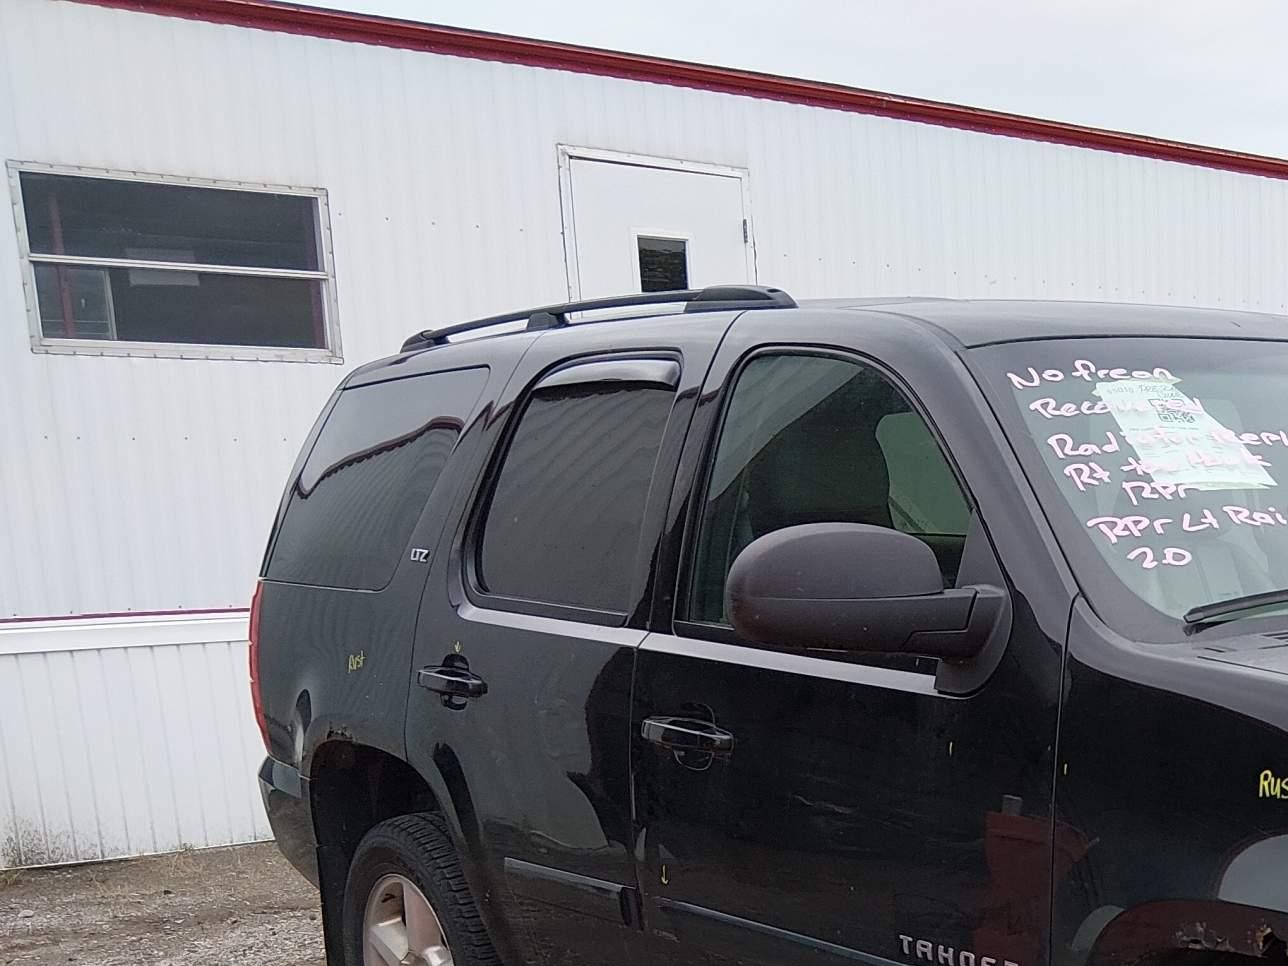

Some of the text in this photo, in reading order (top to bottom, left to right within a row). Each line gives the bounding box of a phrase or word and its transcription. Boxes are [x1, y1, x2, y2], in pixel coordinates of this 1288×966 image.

[1006, 359, 1175, 389] No freon
[1064, 462, 1112, 491] Rt
